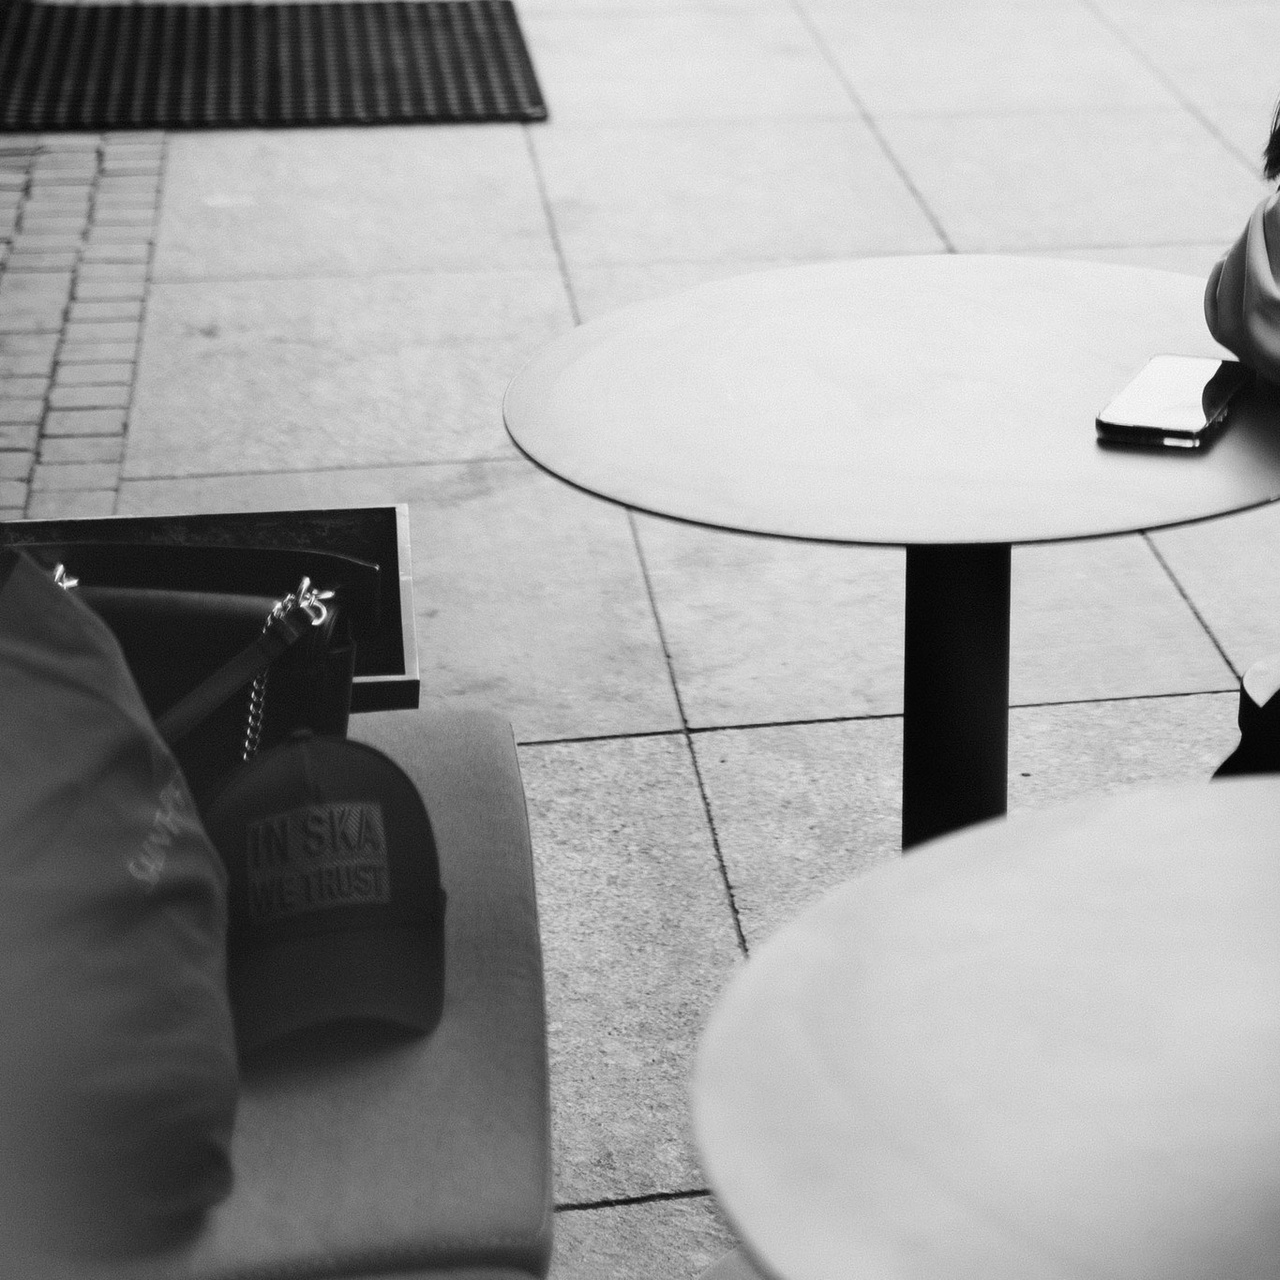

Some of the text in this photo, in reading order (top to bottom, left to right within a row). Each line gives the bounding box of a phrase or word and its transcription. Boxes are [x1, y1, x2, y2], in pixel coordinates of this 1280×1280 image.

[251, 819, 289, 868] IN
[302, 808, 381, 857] SKA
[250, 865, 385, 916] WE TRUST
